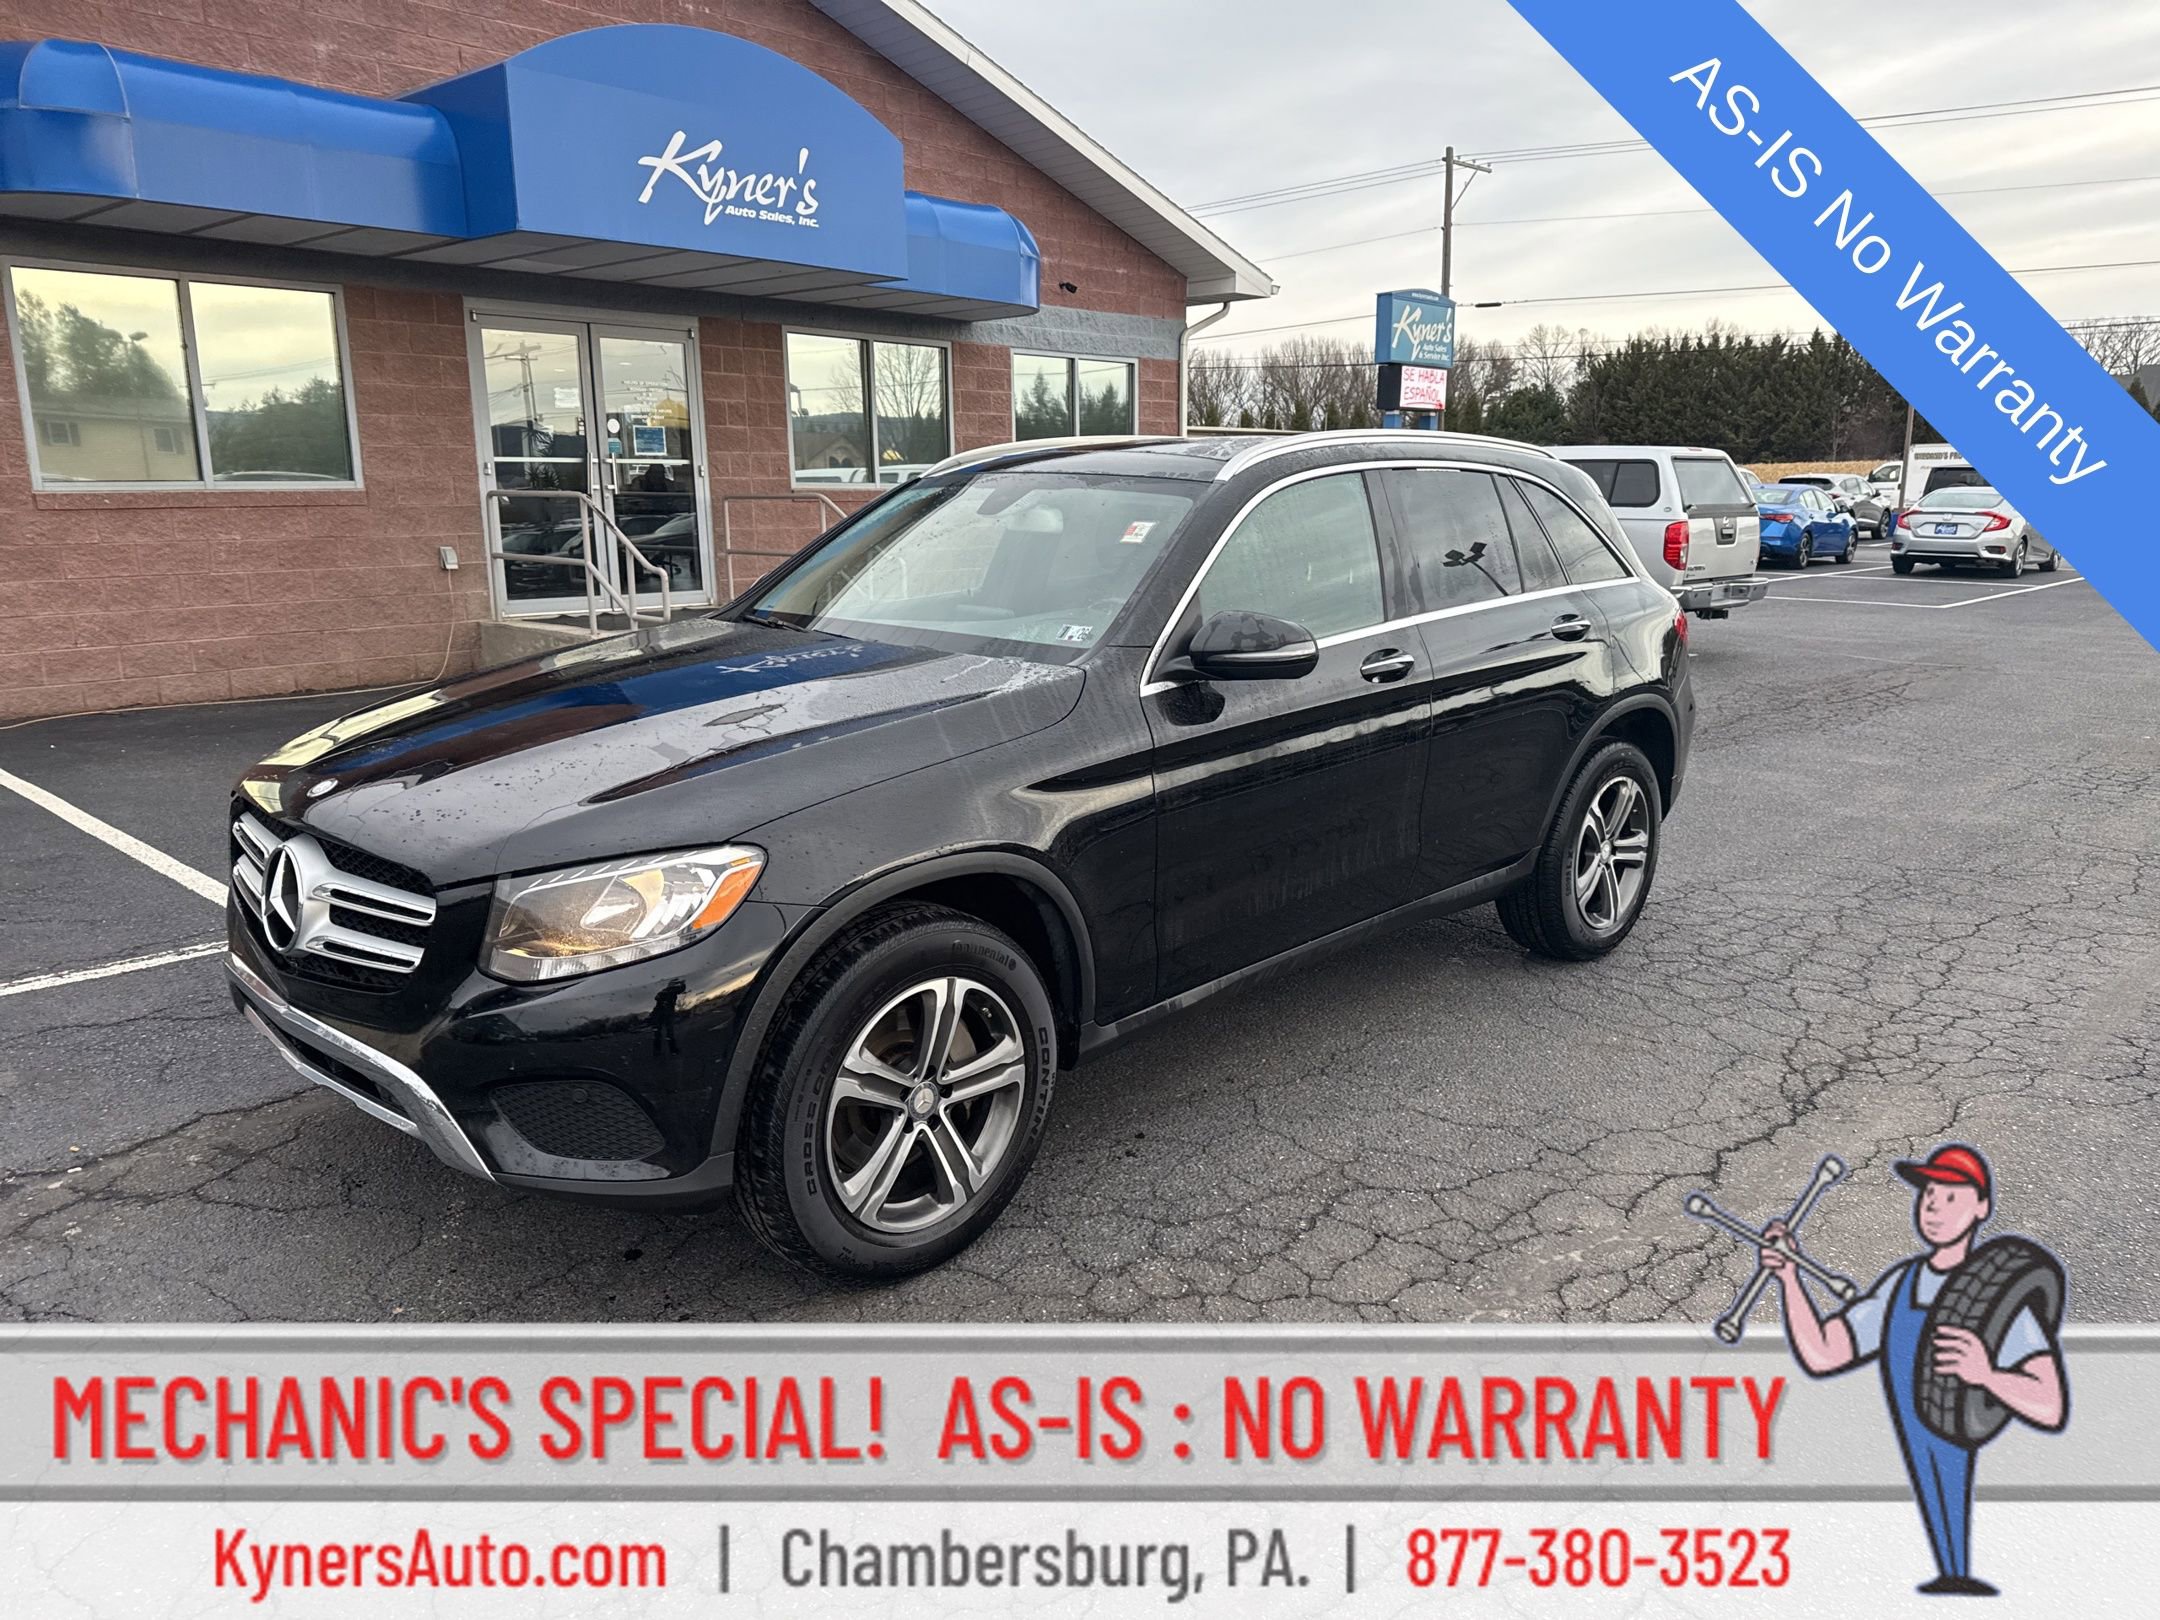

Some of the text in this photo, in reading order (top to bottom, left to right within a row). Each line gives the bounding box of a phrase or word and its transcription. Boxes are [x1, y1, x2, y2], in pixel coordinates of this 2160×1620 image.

[638, 130, 818, 226] Kyner's
[725, 205, 820, 228] Auto Sales, Inc.
[1391, 304, 1452, 361] Kyner's
[1403, 368, 1445, 384] SE HABLA
[1404, 385, 1441, 402] ESPAÑOL
